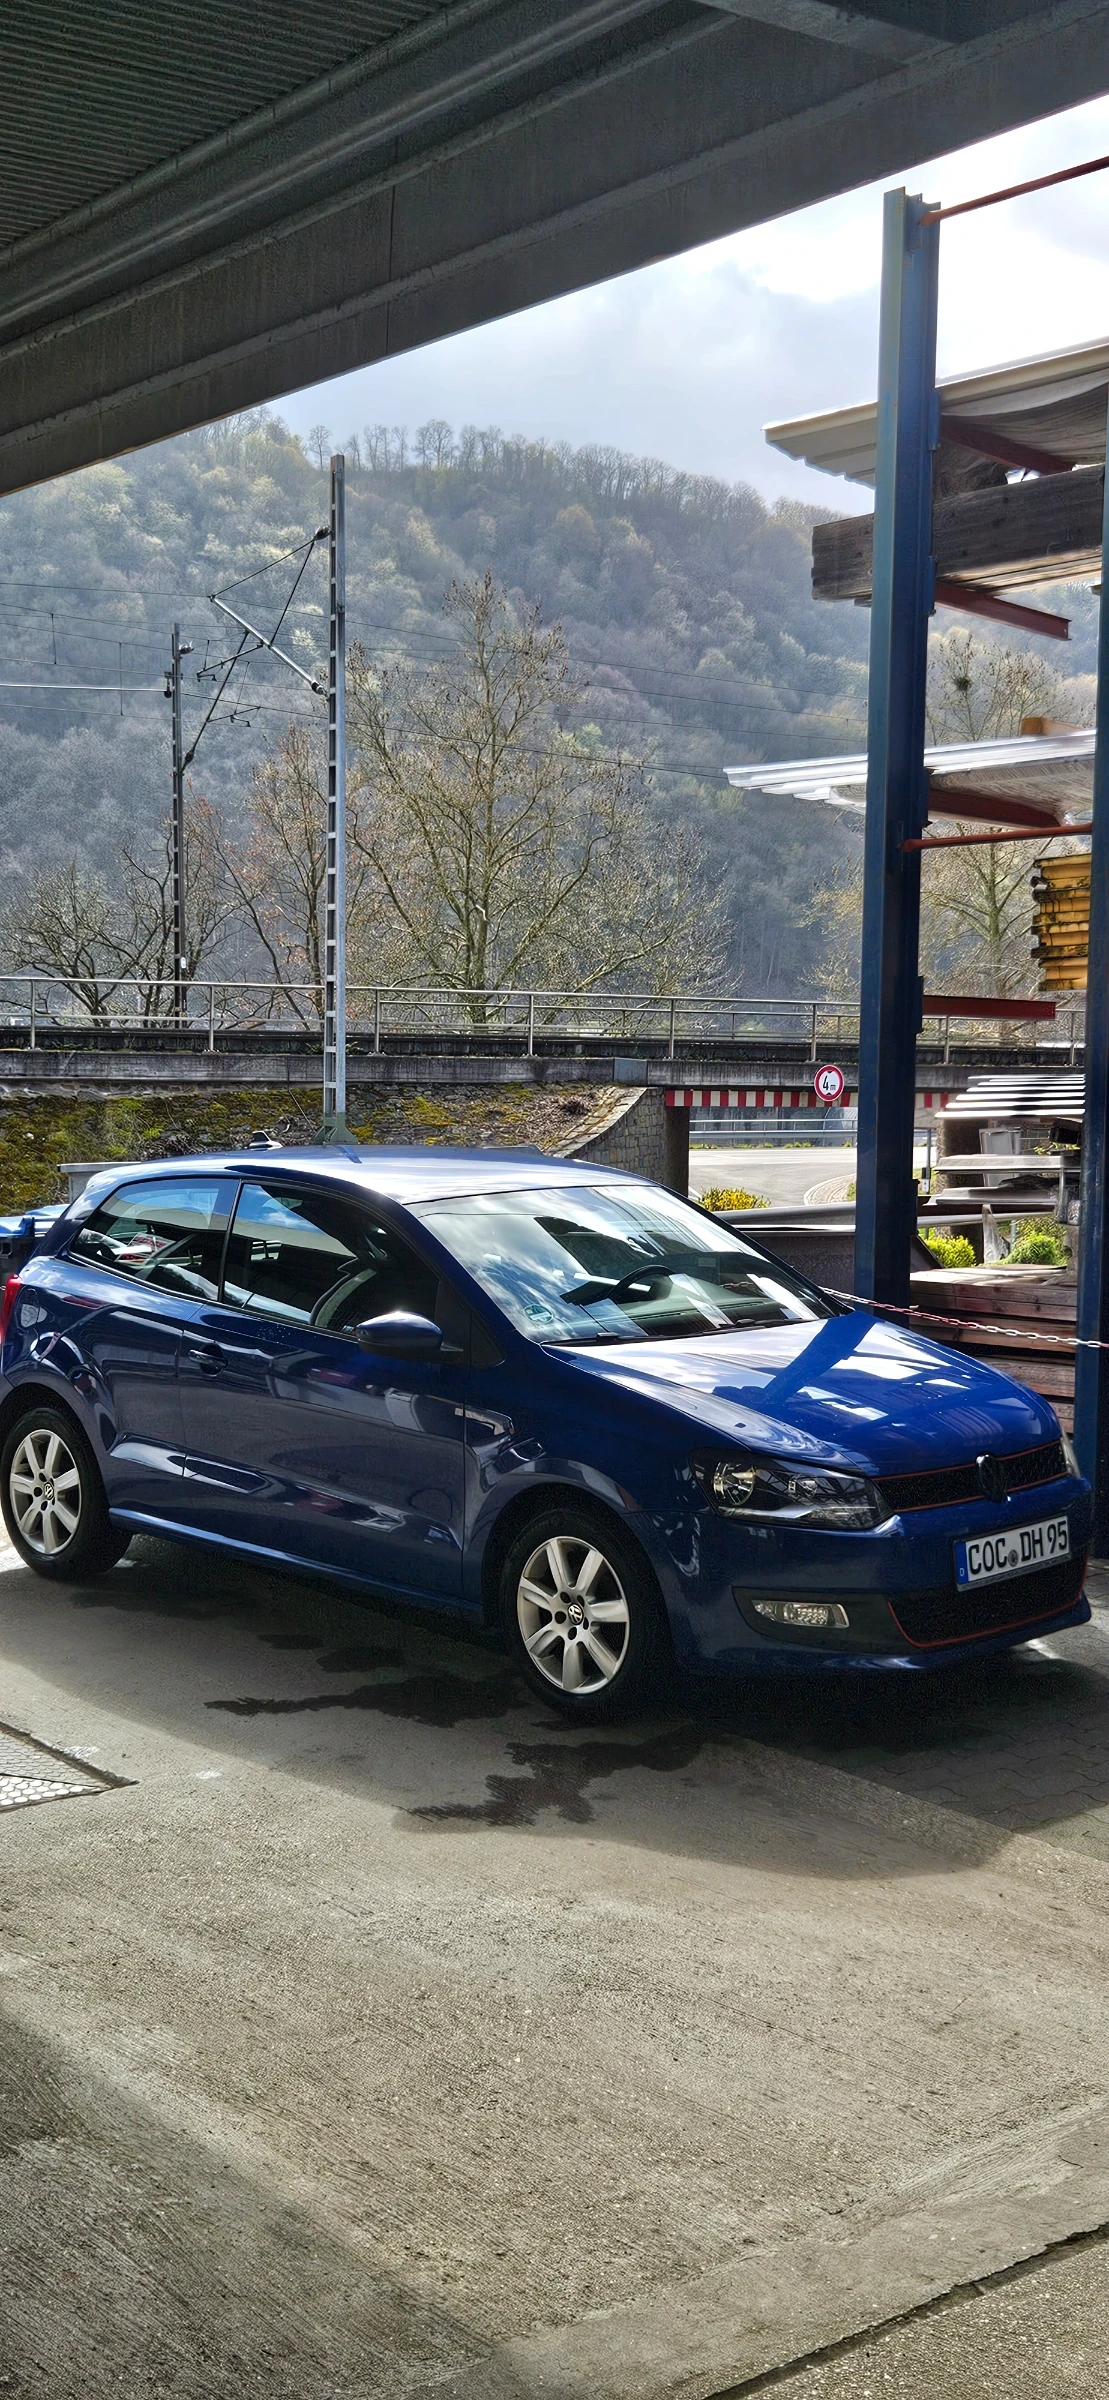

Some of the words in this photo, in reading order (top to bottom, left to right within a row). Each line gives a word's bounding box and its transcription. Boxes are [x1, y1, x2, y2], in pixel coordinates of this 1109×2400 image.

[968, 1537, 1008, 1575] COC
[1019, 1527, 1044, 1562] DH
[1047, 1520, 1068, 1554] 95
